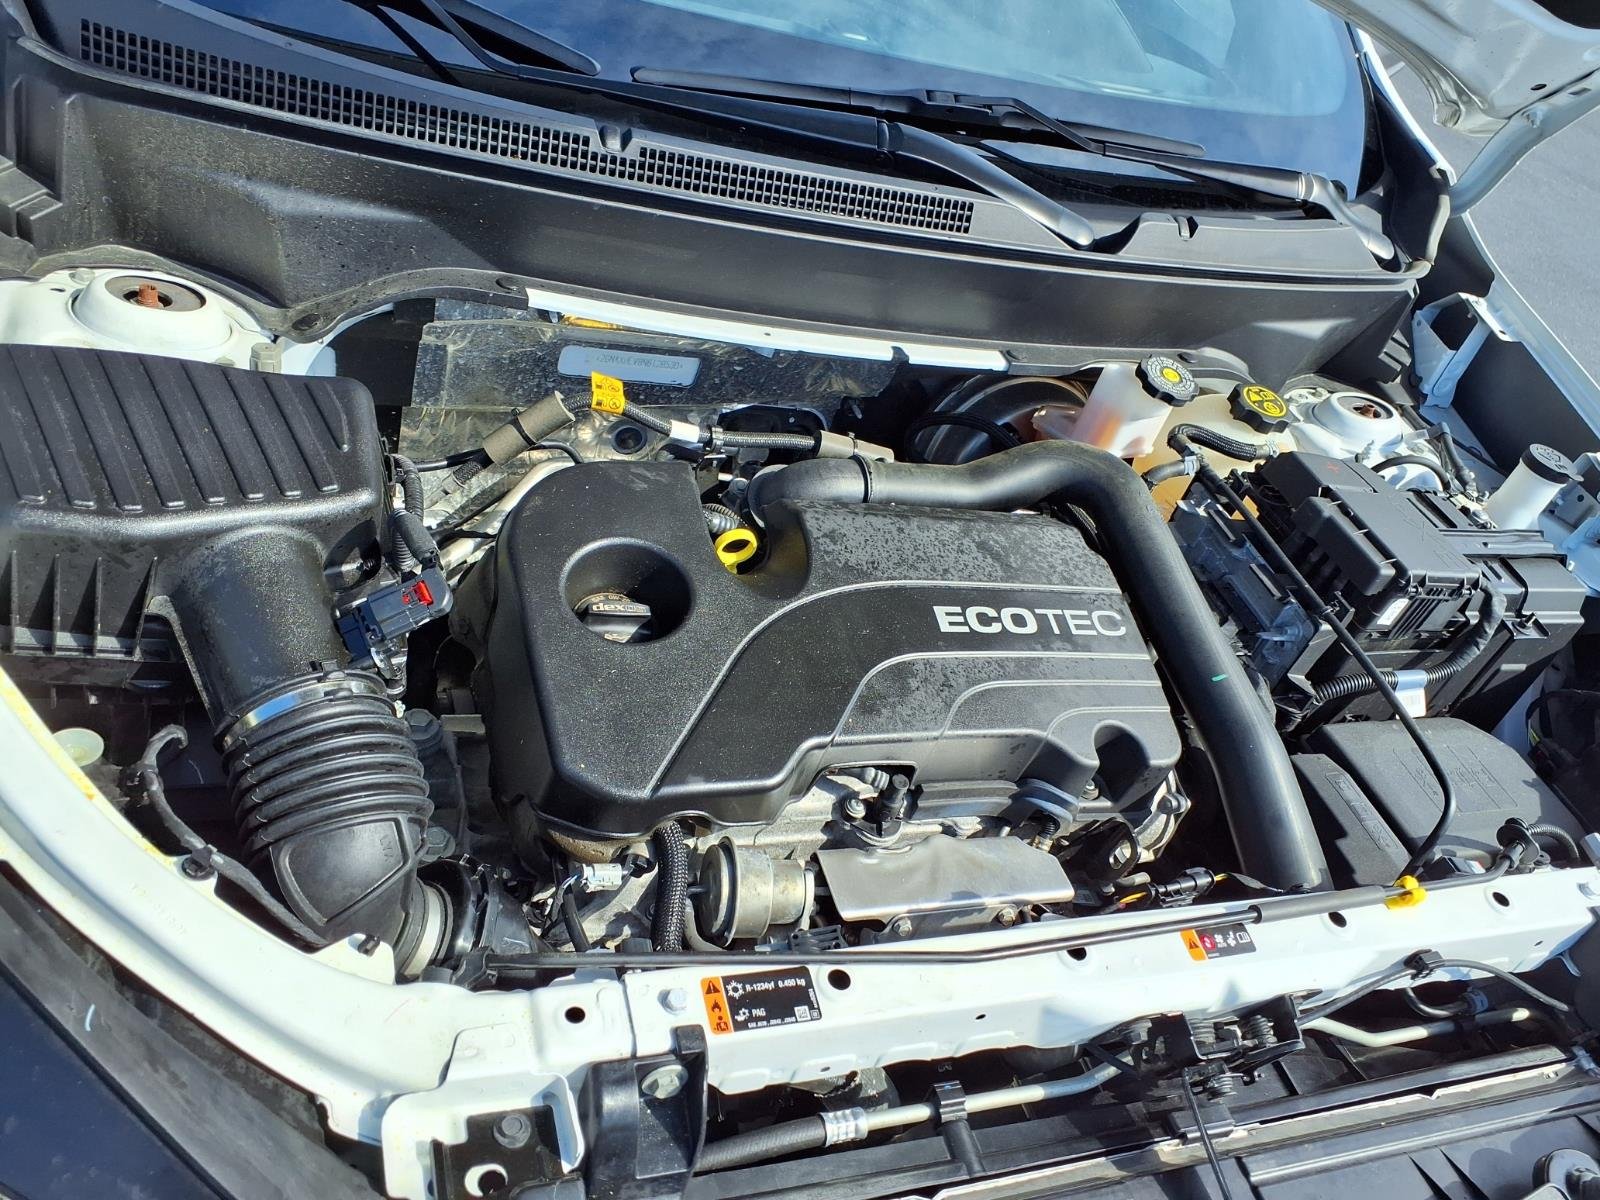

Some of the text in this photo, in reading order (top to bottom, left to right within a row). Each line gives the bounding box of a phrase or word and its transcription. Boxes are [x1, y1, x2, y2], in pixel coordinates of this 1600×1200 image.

[932, 605, 1127, 637] ECOTEC
[796, 978, 806, 987] kg
[751, 1008, 766, 1018] PAG
